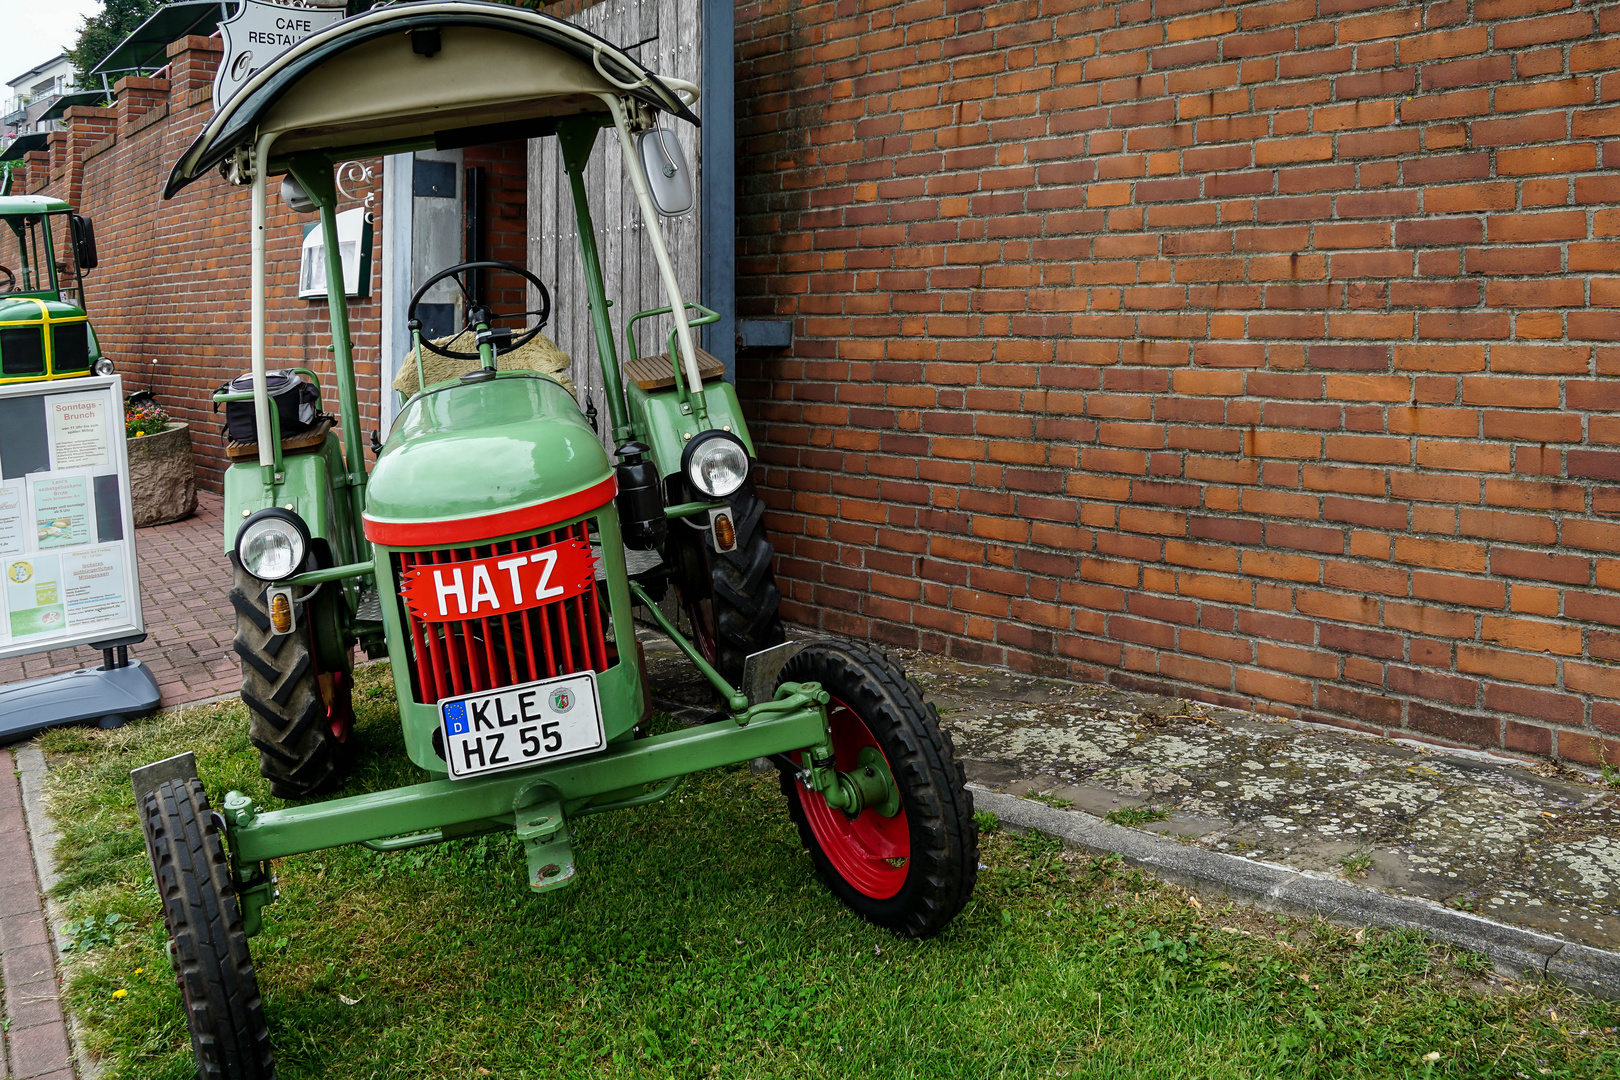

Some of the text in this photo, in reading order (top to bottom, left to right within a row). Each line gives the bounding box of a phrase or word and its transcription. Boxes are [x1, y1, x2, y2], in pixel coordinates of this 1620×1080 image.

[276, 18, 311, 32] CAFE
[56, 402, 96, 412] Sonntags
[64, 411, 95, 420] Brunch
[433, 550, 564, 616] HATZ
[472, 691, 541, 731] KLE
[454, 722, 463, 733] D
[462, 721, 562, 769] HZ 55
